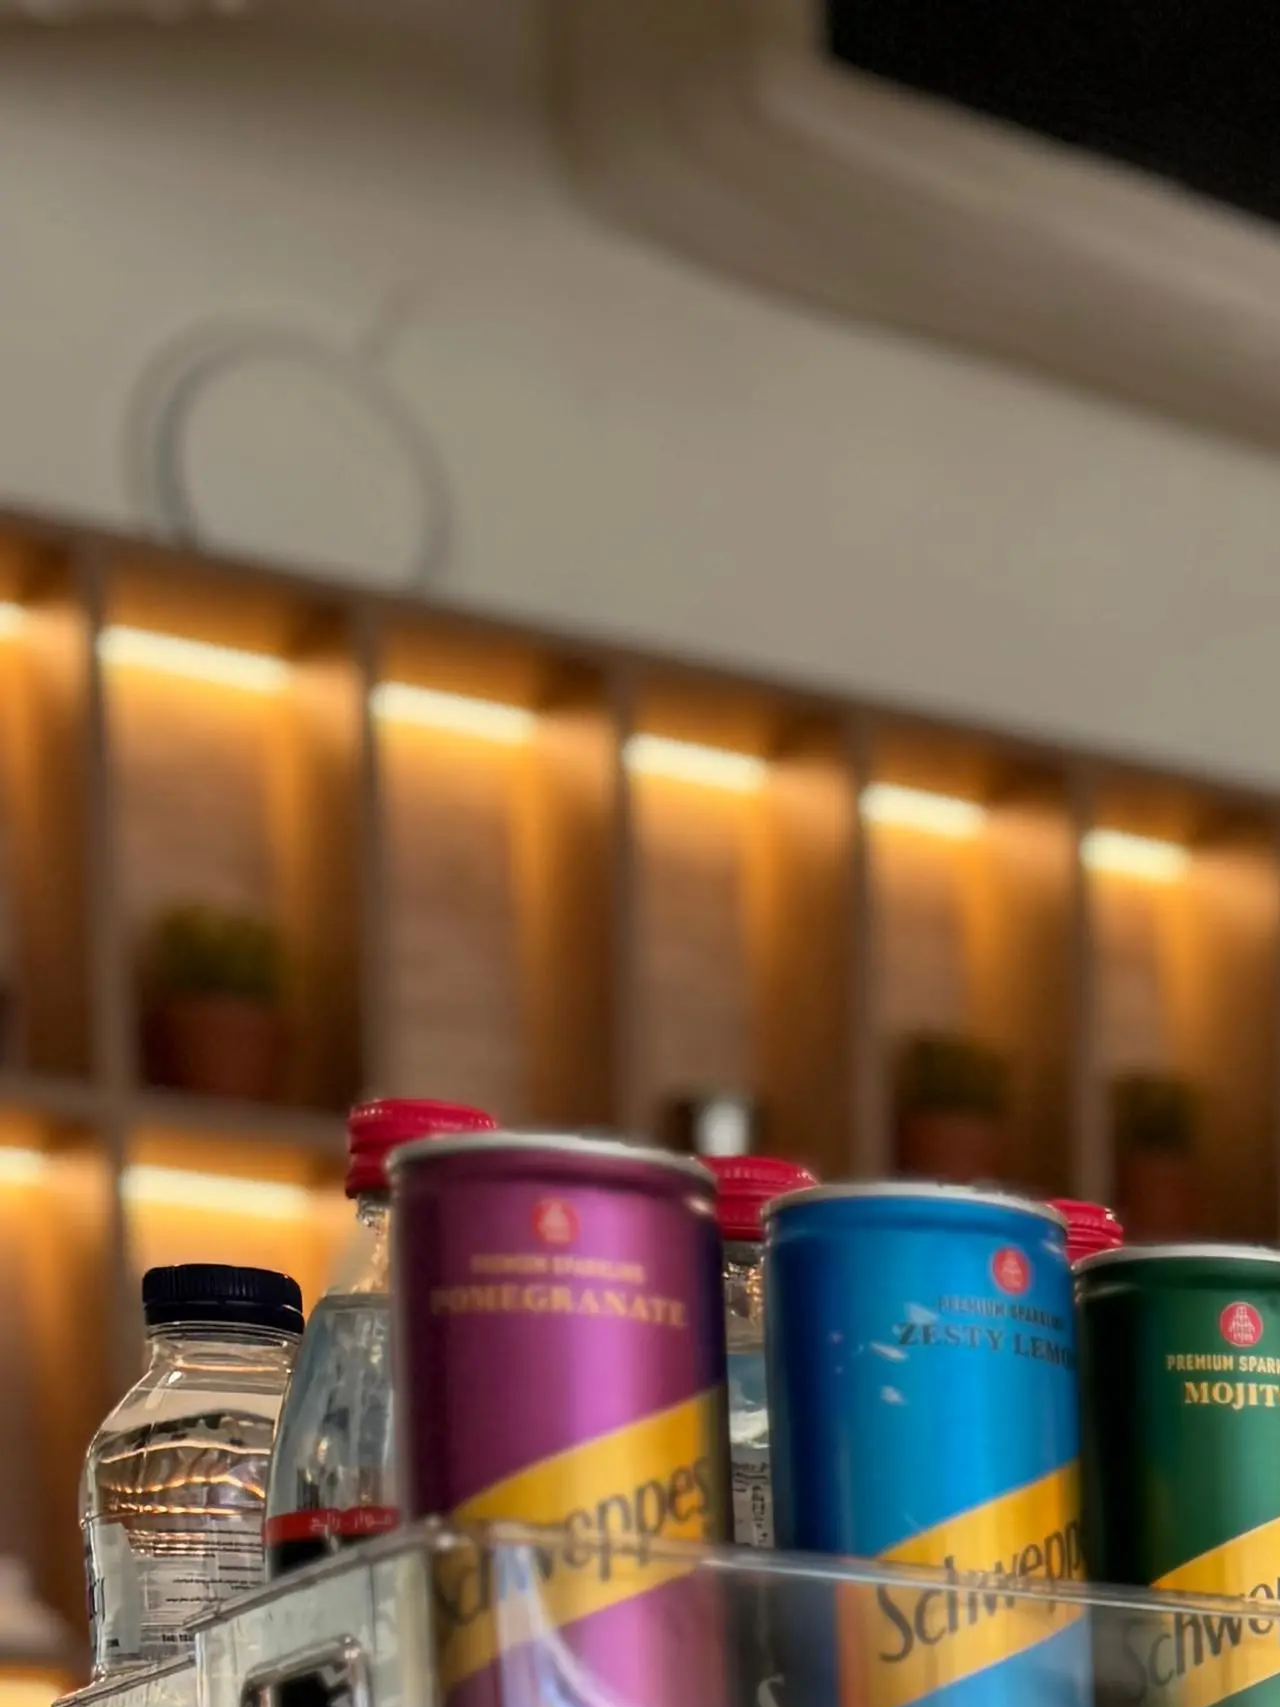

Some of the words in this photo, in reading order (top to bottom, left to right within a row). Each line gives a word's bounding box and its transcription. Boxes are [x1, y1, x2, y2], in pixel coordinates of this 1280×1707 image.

[430, 1284, 688, 1328] POMEGRANATE
[896, 1322, 1004, 1352] ZESTY
[1166, 1354, 1235, 1371] PREMIUM
